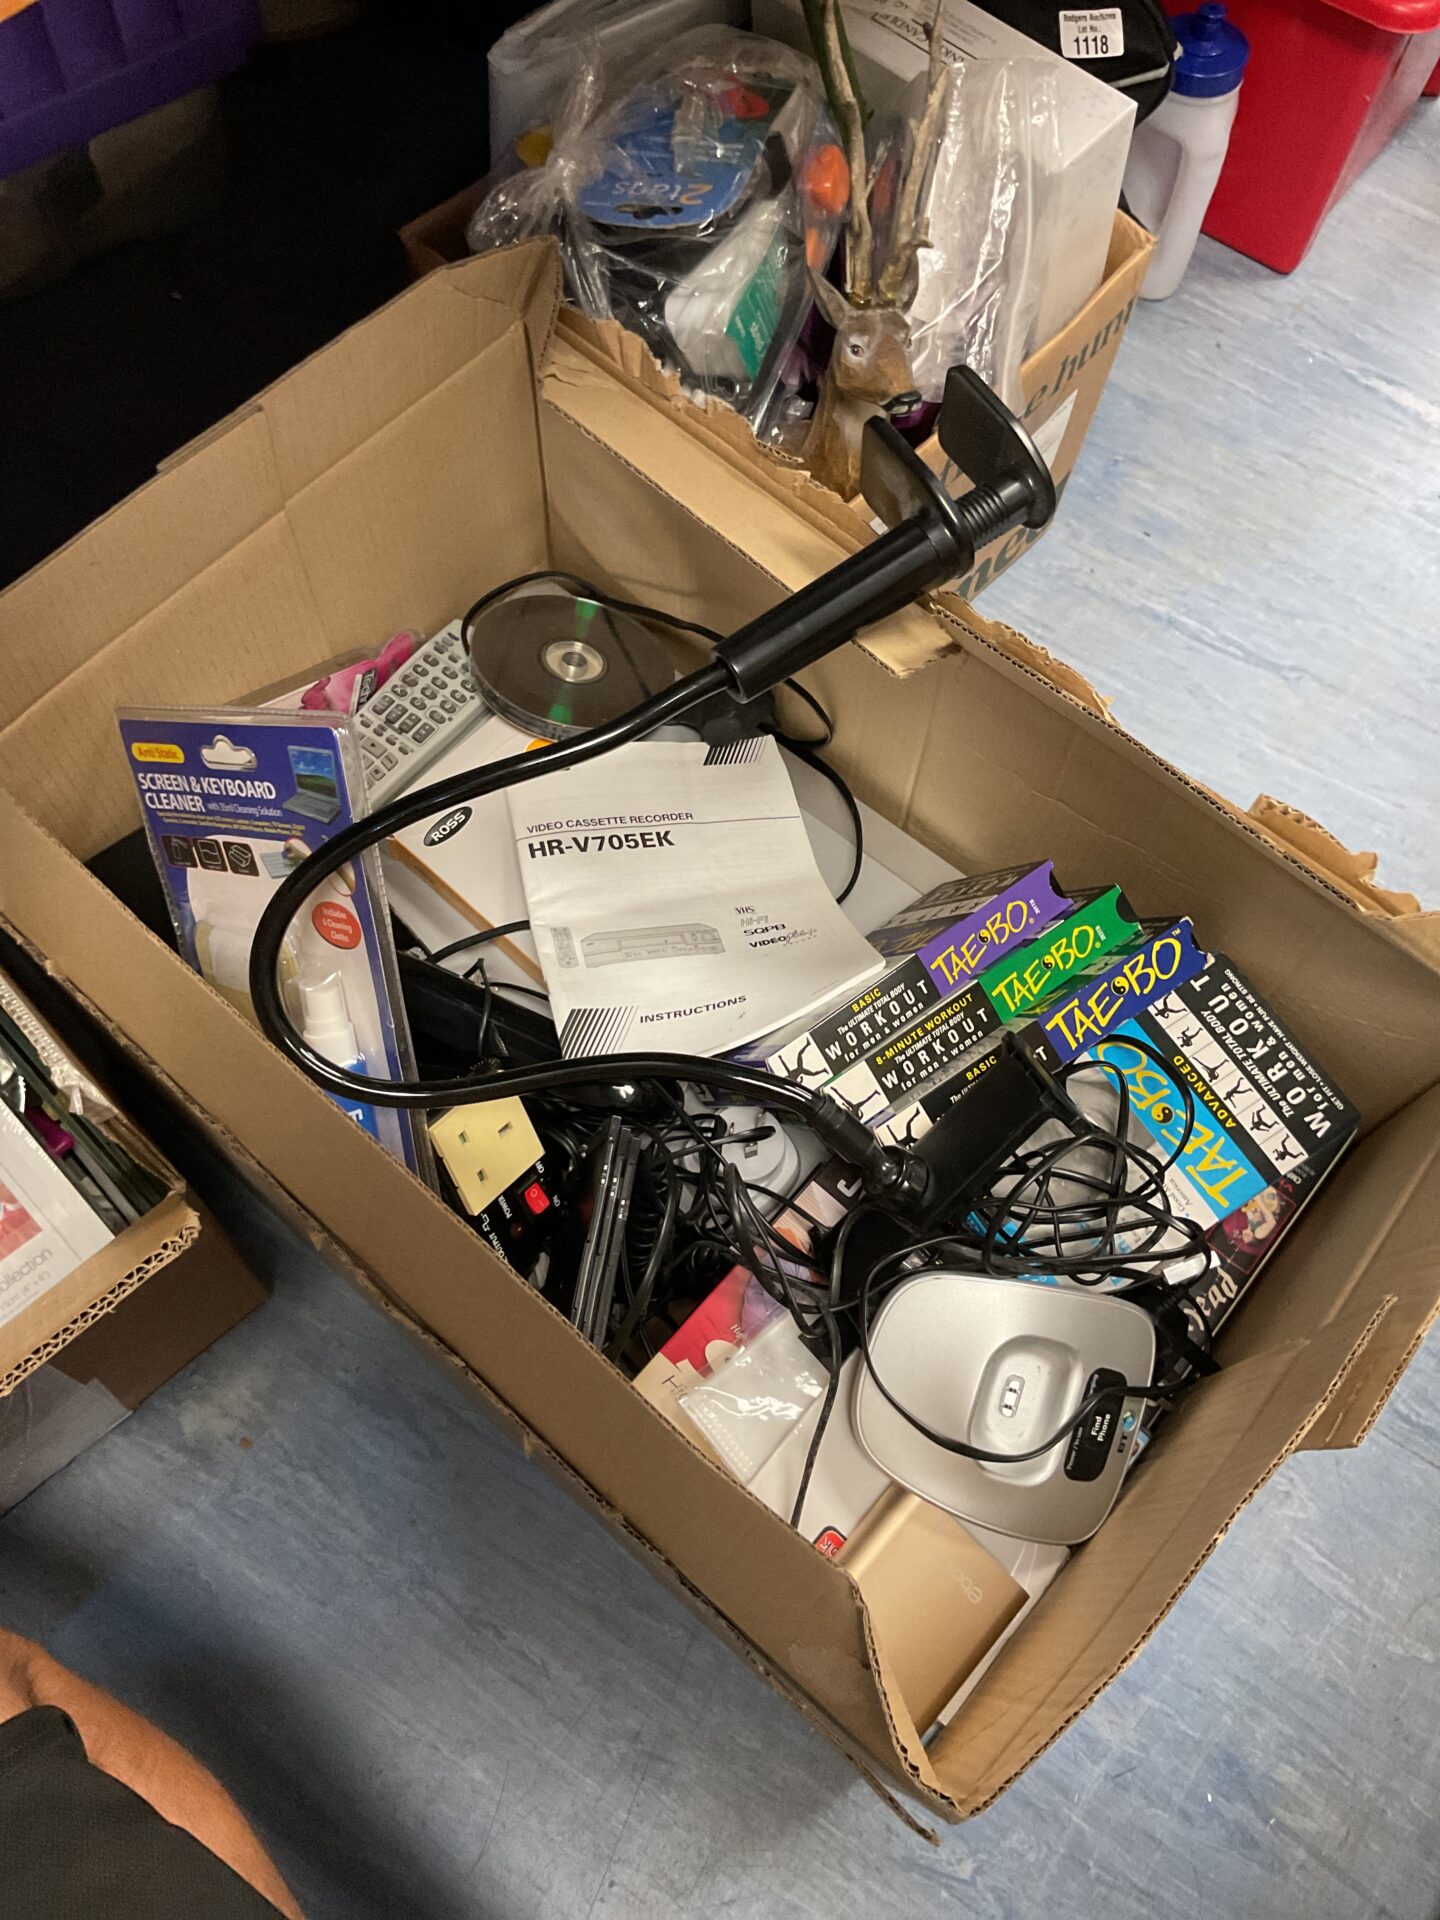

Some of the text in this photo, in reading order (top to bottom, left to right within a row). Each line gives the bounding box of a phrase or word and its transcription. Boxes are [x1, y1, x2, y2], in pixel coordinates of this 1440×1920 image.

[1078, 25, 1087, 33] Lot
[1073, 34, 1109, 55] 1118
[138, 773, 276, 800] SCREEN & KEYBOARD
[144, 792, 206, 812] CLEANER
[431, 811, 466, 842] ROSS
[526, 812, 694, 834] VIDEO CASSETTE RECORDER
[528, 830, 675, 859] HR-V705EK
[735, 906, 756, 915] VHS
[1224, 968, 1247, 995] STRONG
[640, 995, 747, 1023] INSTRUCTIONS
[837, 982, 905, 1036] The ULTIMATE TOTAL BODY
[852, 988, 881, 1013] BASIC
[1255, 1005, 1270, 1021] FUN
[825, 980, 929, 1060] WORKOUT
[845, 1047, 860, 1062] for
[862, 1034, 882, 1049] men
[892, 1001, 924, 1028] women
[875, 993, 974, 1066] 8-MINUTE WORKOUT
[1265, 1020, 1285, 1039] HAVE
[881, 1008, 988, 1090] WORKOUT
[894, 1011, 965, 1065] The ULTIMATE TOTAL BODY
[1221, 982, 1330, 1111] for men & women
[900, 1030, 984, 1092] for men & women
[1189, 974, 1332, 1138] WORKOUT
[1200, 1009, 1295, 1120] The ULTIMATE TOTAL BODY
[1284, 1042, 1308, 1067] WEIGHT
[965, 1055, 998, 1081] BASIC
[1305, 1064, 1322, 1083] LOSE
[950, 1092, 962, 1104] The
[1173, 1055, 1237, 1129] ADVANCED
[1322, 1086, 1333, 1097] FIT
[1330, 1096, 1344, 1110] GET
[498, 1195, 513, 1219] POWER
[489, 1232, 505, 1258] OUTPUT
[0, 1248, 53, 1295] ollection
[1091, 1415, 1103, 1436] Find
[1097, 1413, 1111, 1442] Phone
[1117, 1433, 1128, 1453] BT
